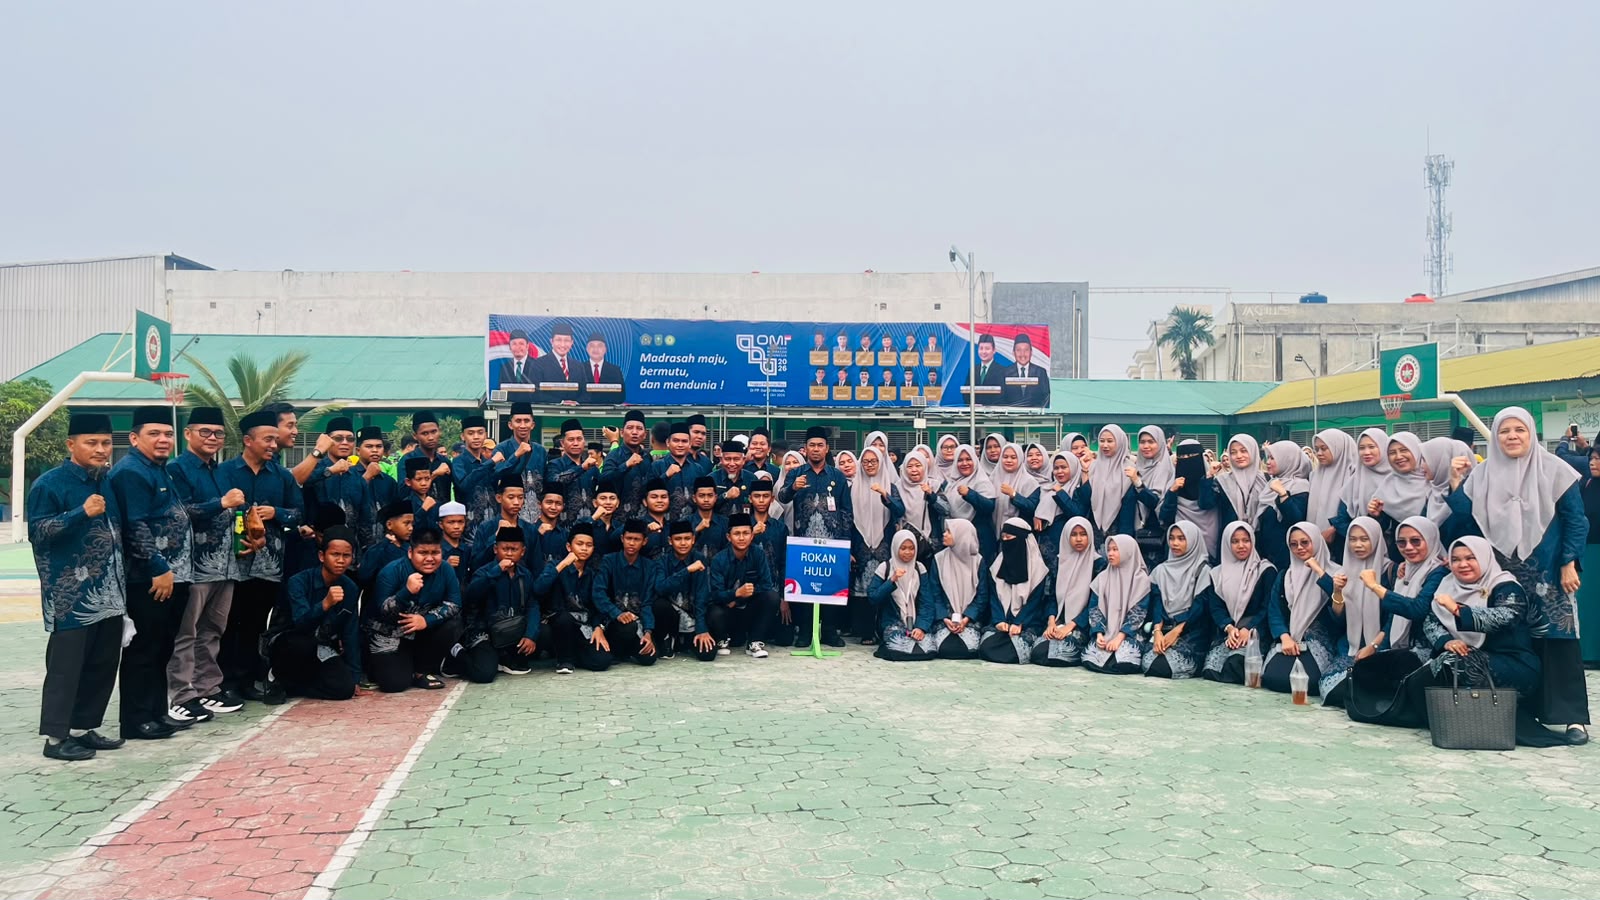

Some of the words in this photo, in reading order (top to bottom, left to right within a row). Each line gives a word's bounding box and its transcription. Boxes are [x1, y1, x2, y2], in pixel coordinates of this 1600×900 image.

[757, 334, 787, 346] OMI
[640, 352, 695, 363] Madrasah
[697, 353, 728, 366] maju,
[640, 365, 689, 378] bermutu,
[640, 379, 660, 389] dan
[663, 379, 717, 390] mendunia
[720, 379, 725, 390] !
[801, 552, 836, 563] ROKAN
[803, 566, 832, 577] HULU
